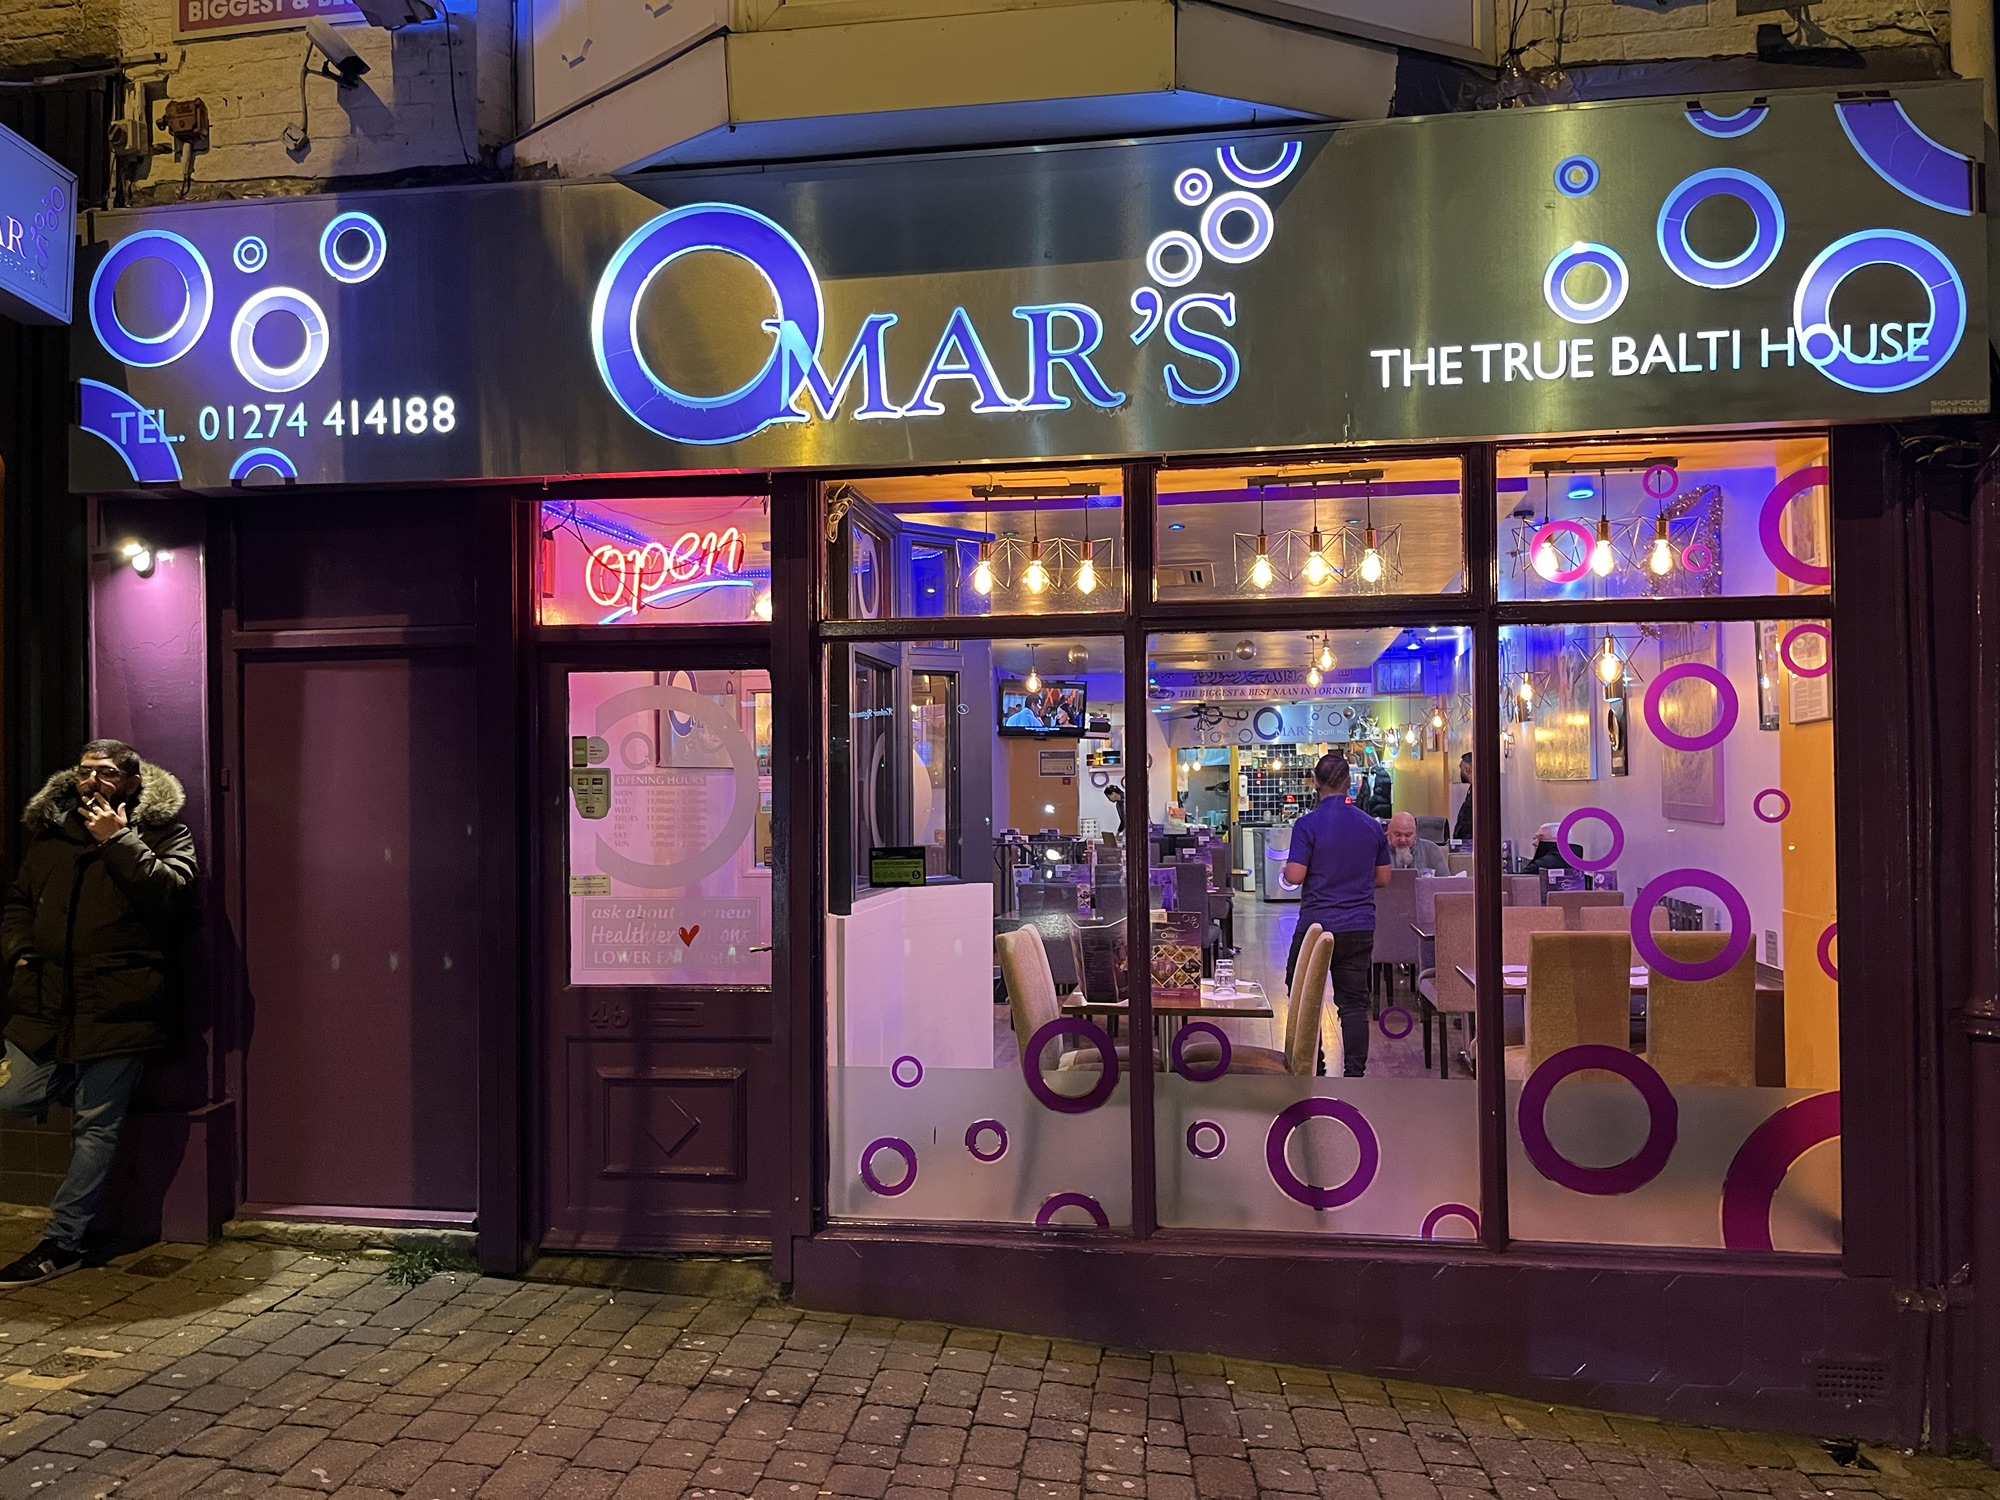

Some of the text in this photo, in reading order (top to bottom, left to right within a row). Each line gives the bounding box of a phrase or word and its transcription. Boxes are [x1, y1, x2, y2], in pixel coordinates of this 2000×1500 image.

[188, 0, 283, 22] BIGGEST
[592, 201, 1241, 446] OMAR'S
[1370, 321, 1930, 388] THE TRUE BALTI HOUSE
[111, 395, 456, 445] TEL. 01274 414188
[1179, 690, 1197, 698] THE
[1200, 689, 1240, 697] BIGGEST
[1240, 688, 1246, 696] &
[1248, 688, 1271, 696] BEST
[1273, 687, 1300, 696] NAAN
[1301, 687, 1310, 695] IN
[1314, 686, 1368, 695] YORKSHIRE
[616, 775, 705, 785] OPENING HOURS
[591, 904, 622, 919] ask
[625, 904, 675, 919] about
[714, 907, 751, 919] new
[591, 922, 676, 944] Healthier
[594, 950, 652, 964] LOWER
